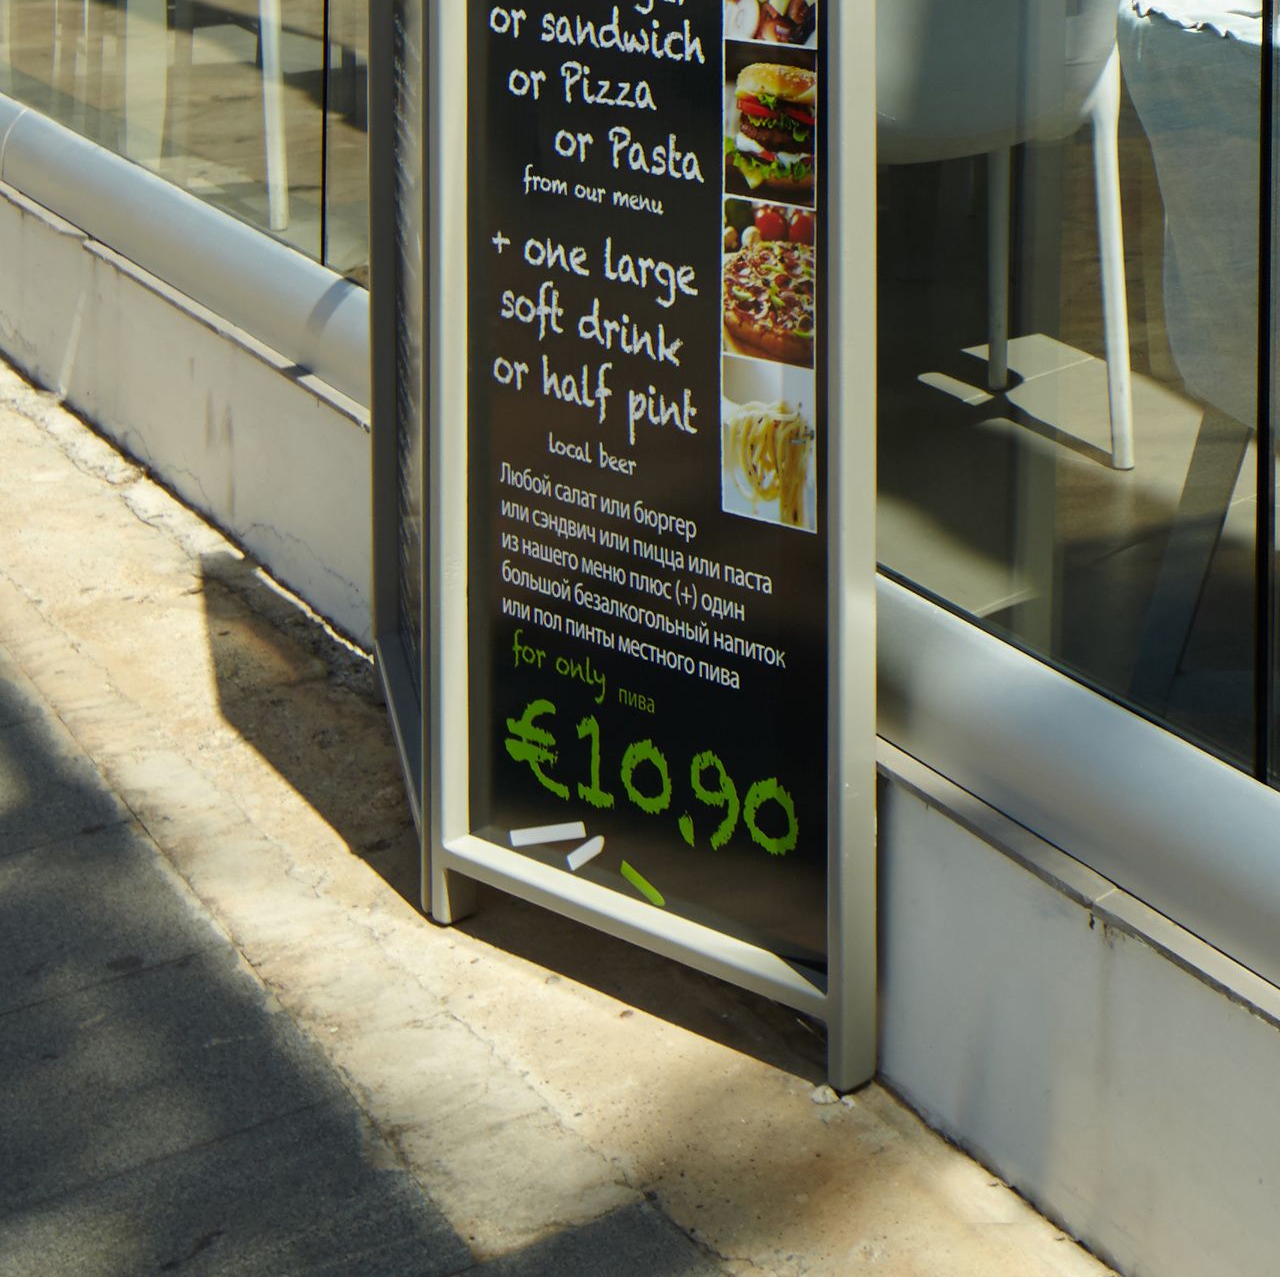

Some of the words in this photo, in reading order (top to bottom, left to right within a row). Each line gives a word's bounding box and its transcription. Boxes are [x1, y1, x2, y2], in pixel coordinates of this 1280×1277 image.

[490, 6, 527, 37] or
[541, 6, 705, 64] sandwich
[509, 69, 545, 99] or
[562, 61, 657, 110] Pizza
[523, 164, 568, 195] from
[575, 181, 605, 203] our
[613, 190, 664, 215] menu
[555, 130, 593, 162] or
[609, 127, 704, 183] Pasta
[524, 238, 589, 276] one
[605, 237, 698, 308] large
[501, 281, 563, 341] soft
[579, 298, 683, 367] drink
[493, 357, 529, 390] or
[542, 355, 612, 424] half
[628, 385, 697, 445] pint
[549, 432, 592, 464] local
[600, 442, 637, 475] beer
[500, 462, 551, 498] Любой
[554, 482, 597, 511] салат
[601, 496, 631, 521] или
[633, 500, 697, 543] бюргер
[501, 499, 529, 523] или
[532, 508, 596, 545] сэндвич
[600, 528, 629, 553] или
[633, 539, 685, 572] пицца
[689, 555, 720, 581] или
[724, 566, 773, 595] паста
[501, 532, 519, 552] из
[522, 536, 579, 571] нашего
[581, 555, 626, 586] меню
[630, 570, 672, 601] плюс
[675, 579, 698, 610] (+)
[701, 593, 745, 622] один
[501, 560, 571, 602] большой
[574, 582, 710, 646] безалкогольный
[714, 634, 786, 669] напиток
[502, 596, 530, 620] или
[534, 605, 561, 632] пол
[566, 615, 614, 650] пинты
[618, 635, 695, 675] местного
[699, 661, 740, 690] пива
[513, 629, 546, 668] for
[556, 657, 606, 703] only
[618, 685, 655, 714] пива
